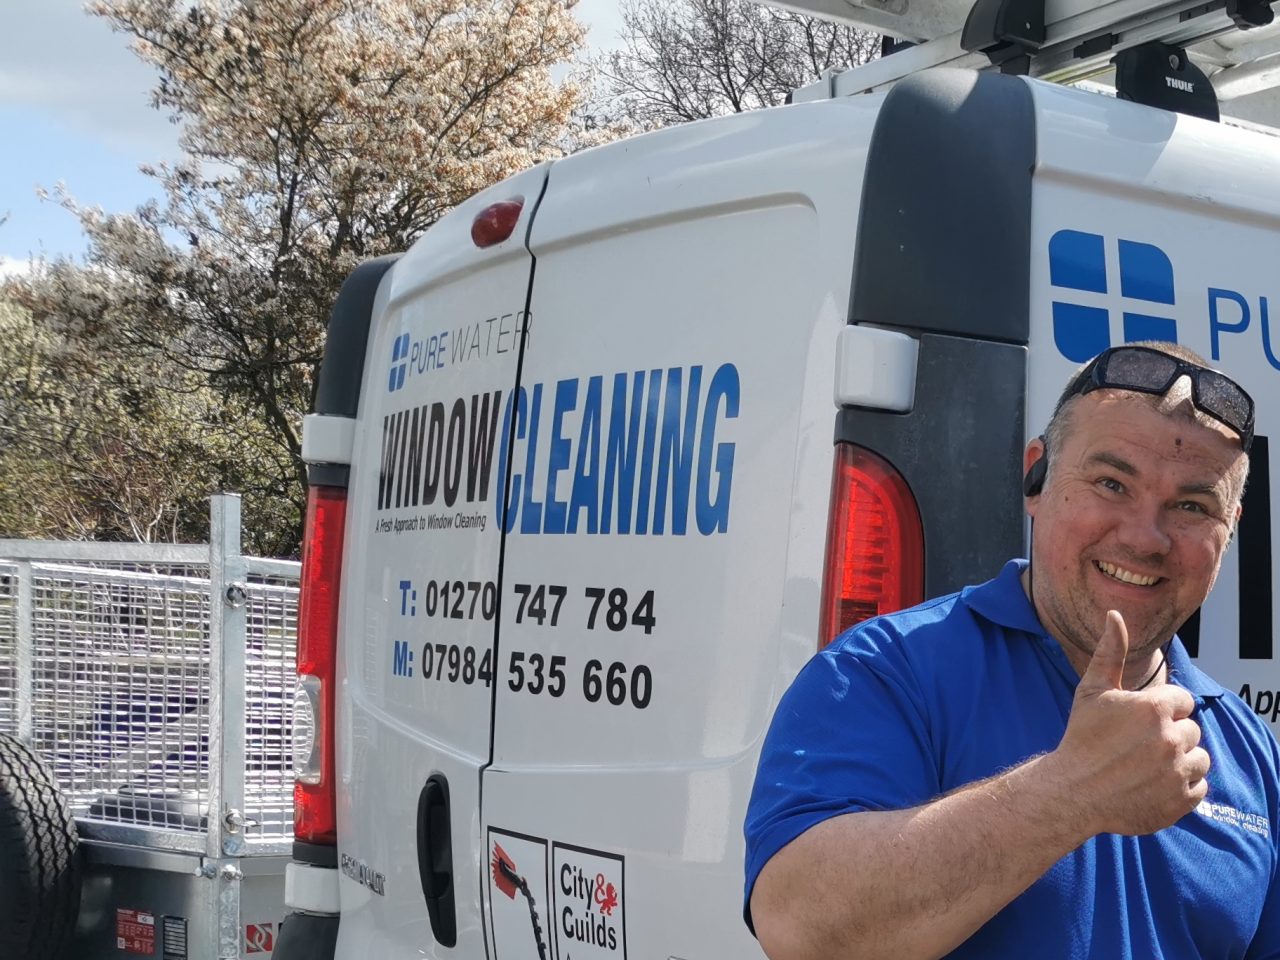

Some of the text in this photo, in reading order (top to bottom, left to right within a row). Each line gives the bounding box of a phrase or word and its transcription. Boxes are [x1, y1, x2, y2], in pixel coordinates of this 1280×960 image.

[1165, 76, 1194, 93] THULE
[409, 311, 533, 376] PURE WATER
[394, 516, 418, 535] Approach
[419, 516, 425, 530] to
[428, 514, 453, 530] Window
[454, 511, 487, 532] Cleaning
[400, 579, 656, 634] T: 01270 747 784
[393, 641, 652, 709] M: 07984 535 660
[562, 906, 617, 950] Guilds
